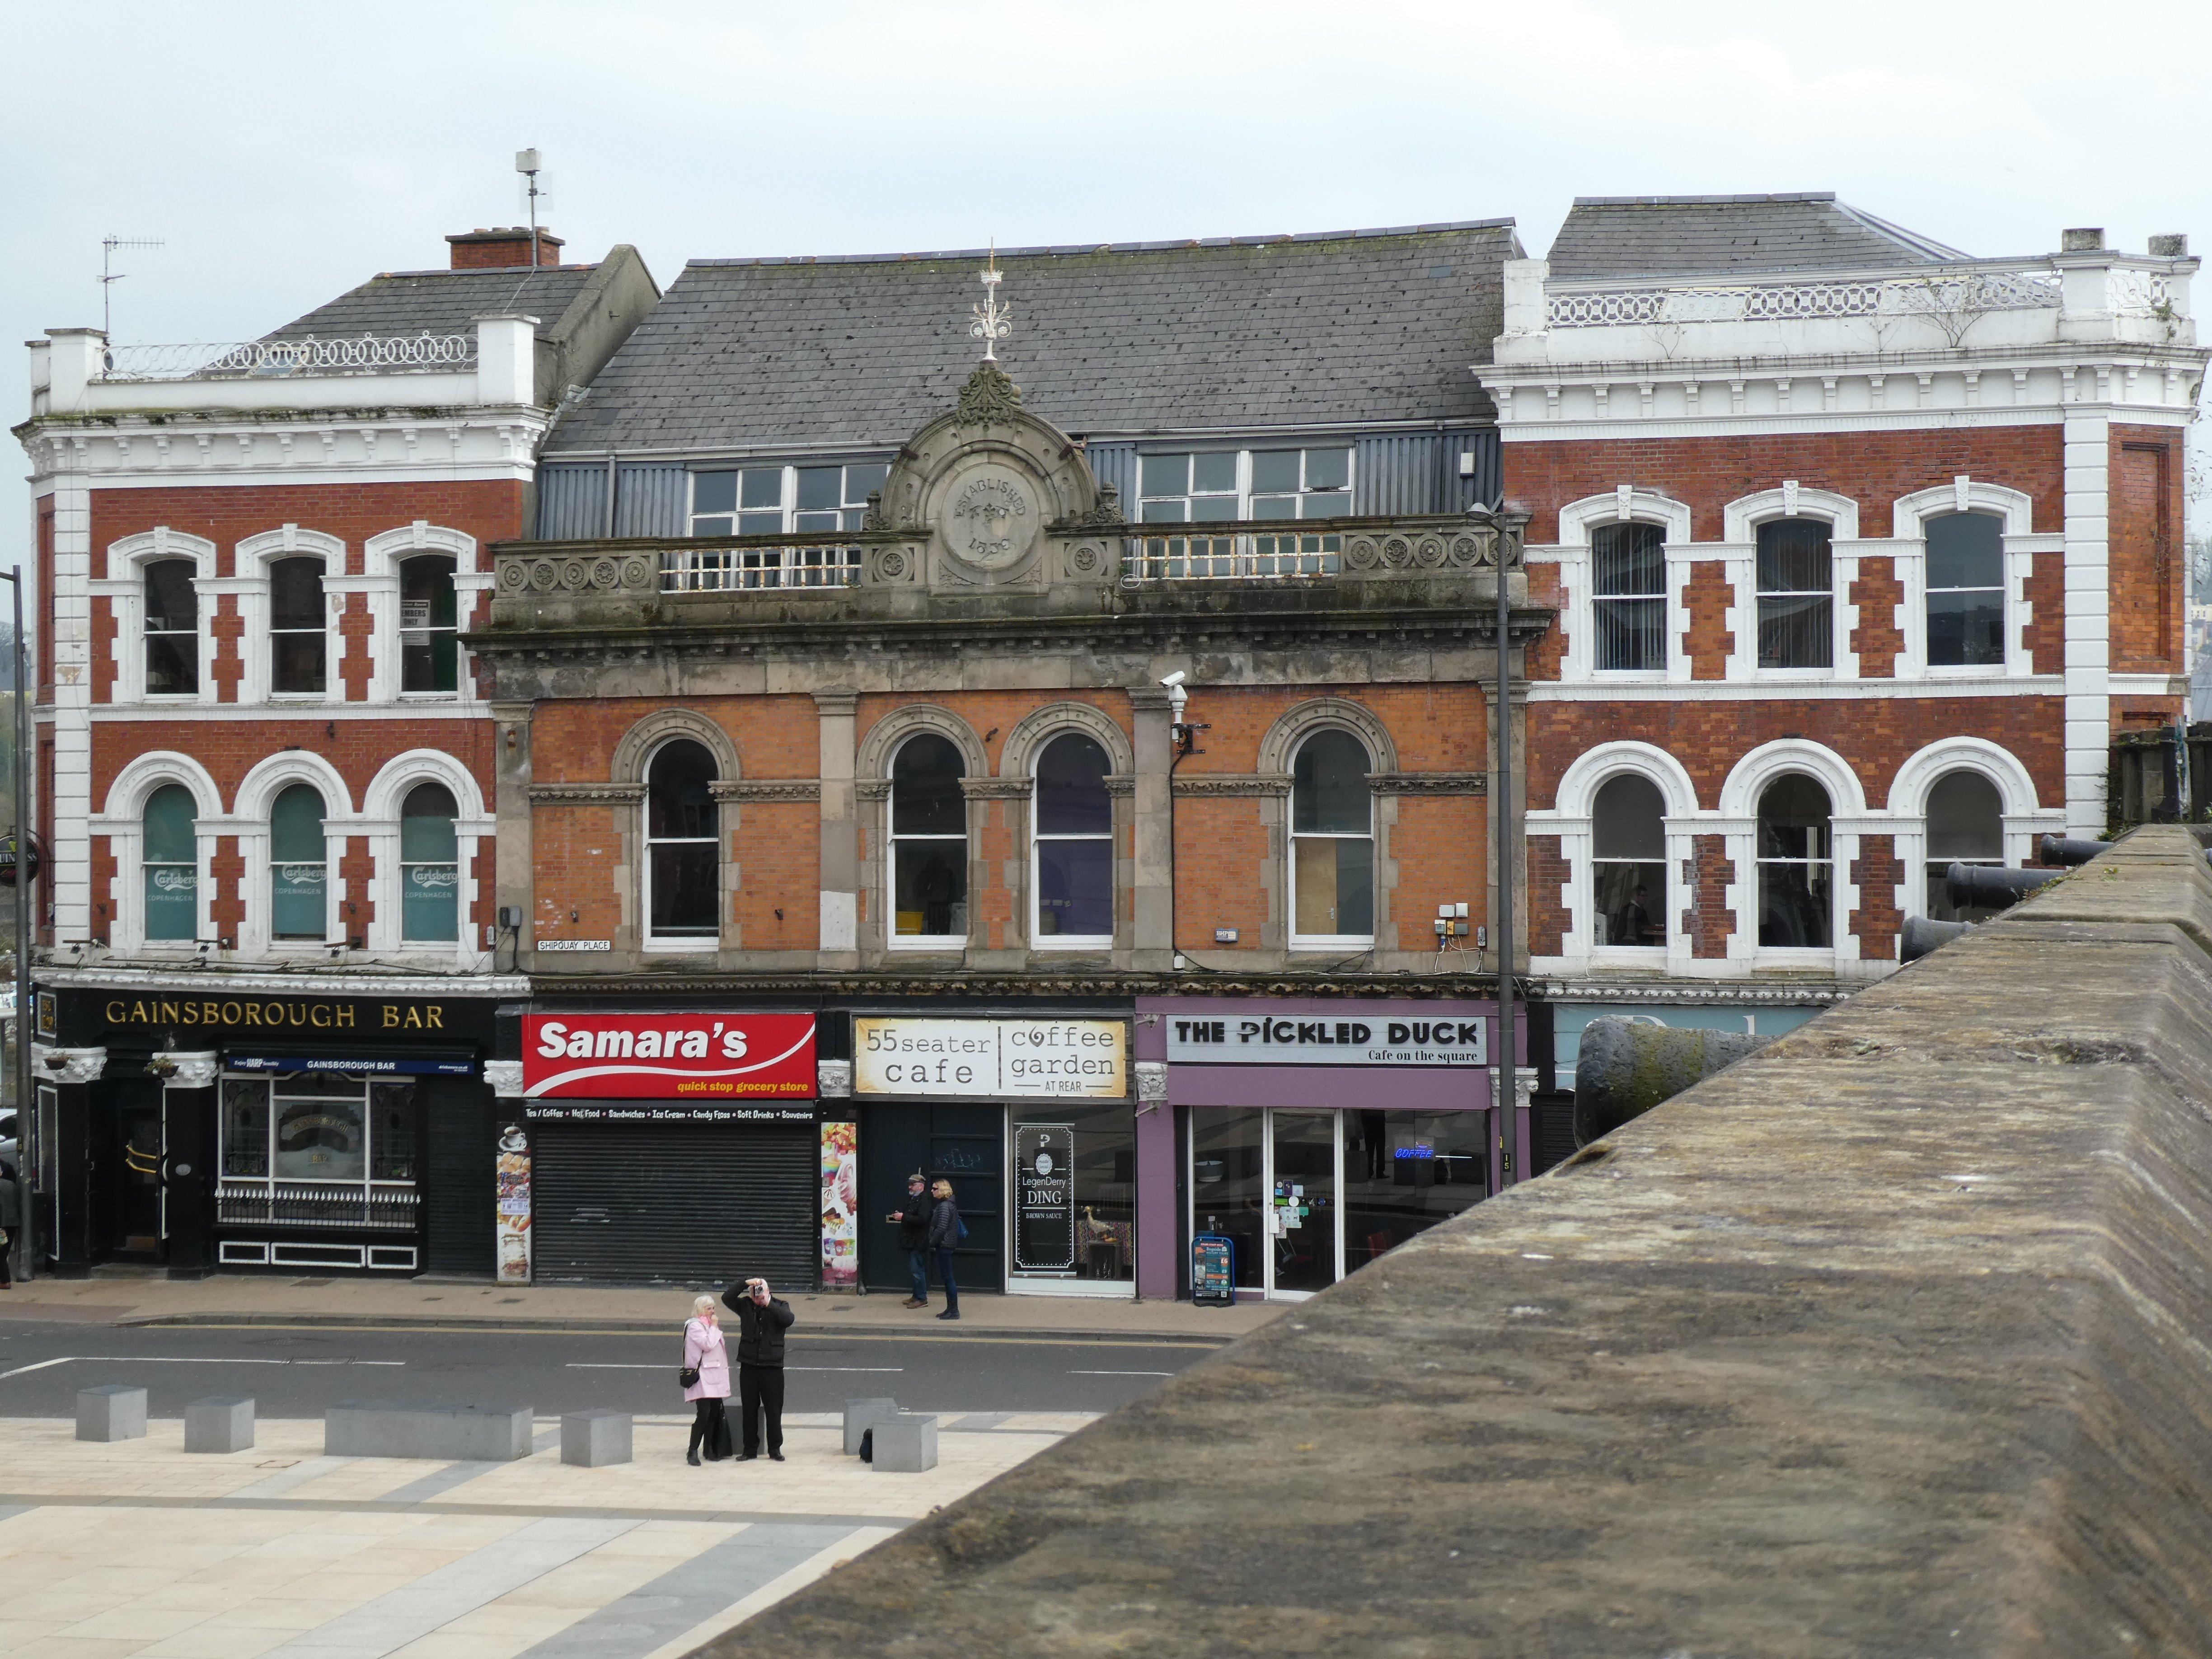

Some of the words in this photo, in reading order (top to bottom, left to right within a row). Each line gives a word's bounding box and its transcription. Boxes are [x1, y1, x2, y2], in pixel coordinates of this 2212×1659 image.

[954, 478, 1025, 519] ESTABLISHED
[412, 866, 458, 886] Carlsberg
[106, 1001, 355, 1027] GAINSBOROUGH
[380, 1005, 444, 1029] BAR
[537, 1022, 747, 1059] Samara's
[1012, 1026, 1114, 1047] coffee
[1175, 1021, 1224, 1042] THE
[1388, 1022, 1477, 1045] DUCK
[902, 1036, 991, 1053] seater
[307, 1060, 375, 1069] GAINSBOROUGH
[377, 1062, 395, 1070] BAR
[1369, 1050, 1392, 1060] Cafe
[1397, 1052, 1411, 1060] on
[1415, 1050, 1434, 1060] the
[1438, 1052, 1477, 1064] square
[886, 1059, 973, 1083] cafe
[1012, 1054, 1115, 1078] garden
[678, 1082, 707, 1092] quick
[710, 1082, 733, 1092] stop
[736, 1082, 778, 1093] grocery
[780, 1082, 808, 1091] store
[1045, 1081, 1055, 1092] AT
[1059, 1081, 1081, 1092] REAR
[526, 1109, 536, 1117] Tea
[543, 1109, 563, 1117] Coffee
[572, 1109, 584, 1118] Hot
[585, 1110, 600, 1118] Food
[609, 1110, 645, 1118] Sandwiches
[652, 1110, 663, 1118] Ice
[665, 1110, 685, 1119] Cream
[693, 1110, 712, 1120] Candy
[714, 1110, 730, 1119] Floss
[737, 1110, 752, 1119] Soft
[753, 1110, 774, 1119] Drinks
[782, 1111, 813, 1119] Souvenirs
[1396, 1148, 1433, 1158] COFFEE
[1022, 1176, 1066, 1188] LegenDerry
[1027, 1190, 1062, 1204] DING
